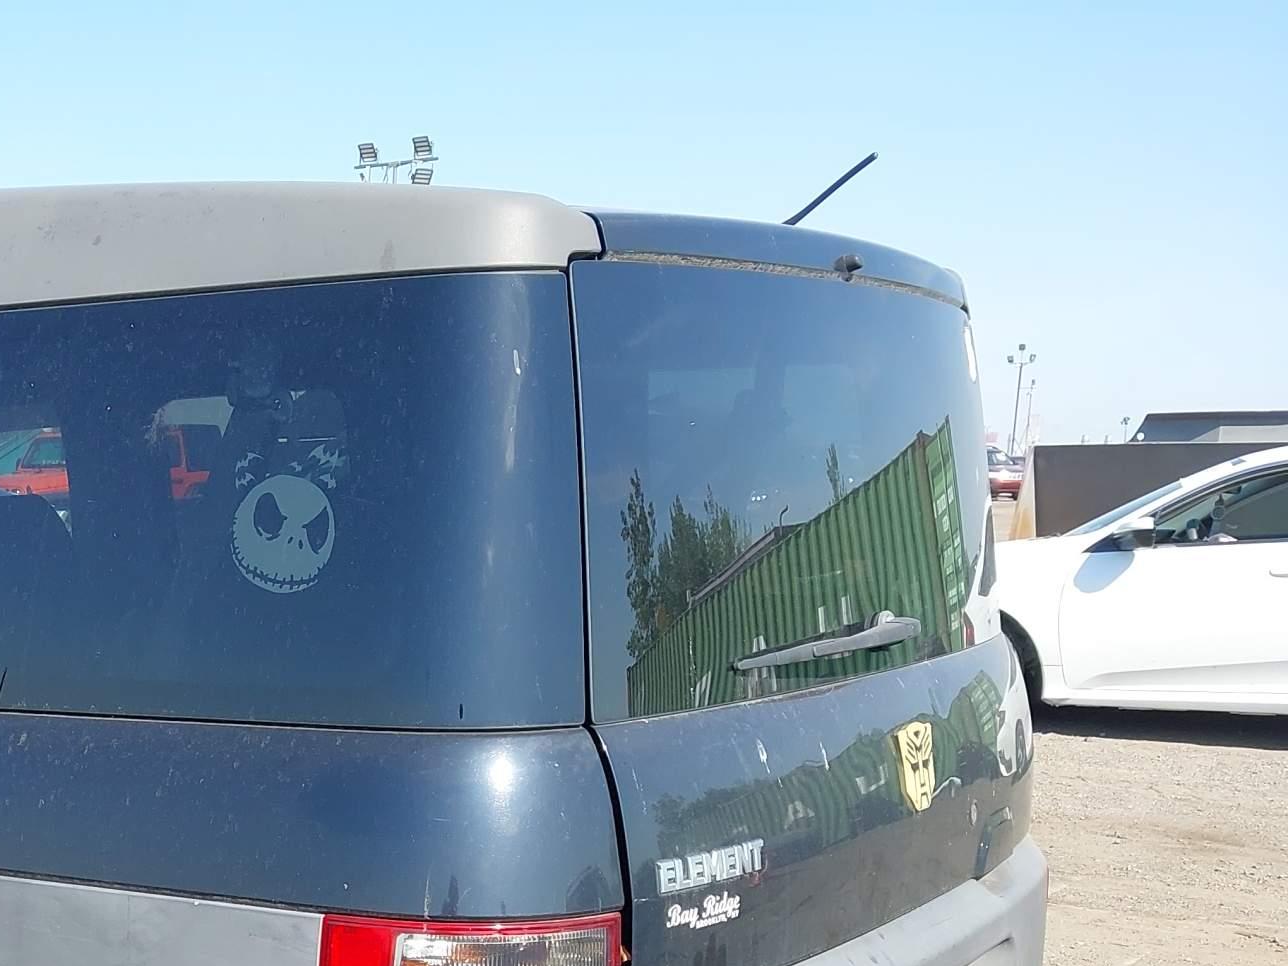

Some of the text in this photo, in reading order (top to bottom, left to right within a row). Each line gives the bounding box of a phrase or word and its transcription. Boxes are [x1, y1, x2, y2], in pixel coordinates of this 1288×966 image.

[656, 838, 765, 895] ELEMENT
[665, 891, 741, 929] Bay Ridge
